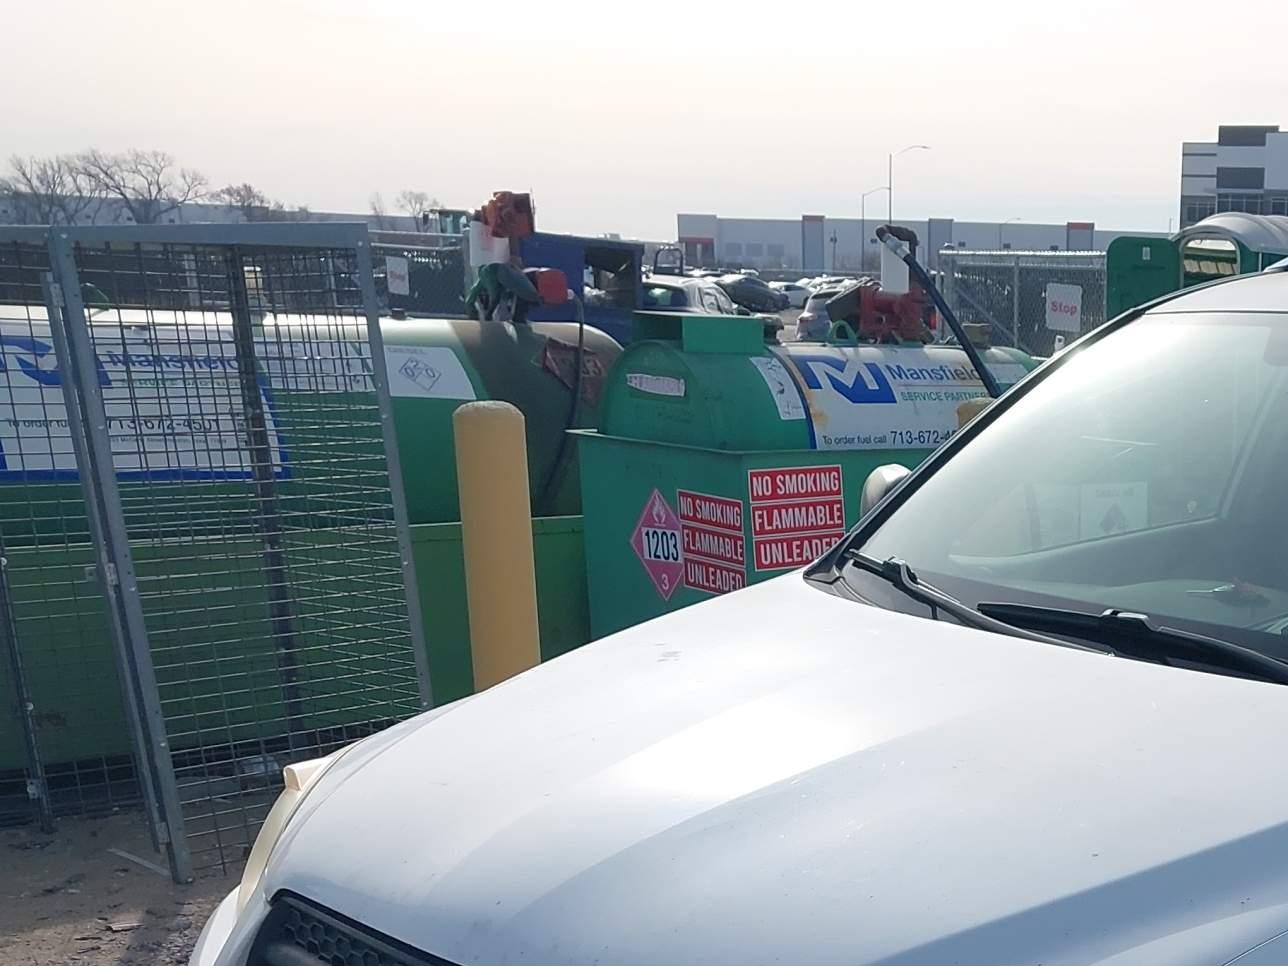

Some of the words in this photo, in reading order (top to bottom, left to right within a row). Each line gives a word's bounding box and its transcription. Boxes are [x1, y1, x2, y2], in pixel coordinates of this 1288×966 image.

[1051, 301, 1078, 316] Stop
[901, 391, 943, 401] SERVICE
[822, 435, 833, 445] To
[834, 435, 856, 444] order
[857, 435, 872, 444] fuel
[873, 435, 887, 444] call
[752, 476, 772, 497] NO
[776, 472, 839, 496] SMOKING
[680, 500, 693, 516] NO
[696, 501, 741, 527] SMOKING
[754, 504, 842, 532] FLAMMABLE
[645, 530, 679, 561] 1203
[684, 528, 744, 561] FLAMMABLE
[661, 574, 670, 591] 3
[687, 562, 743, 591] UNLEADED
